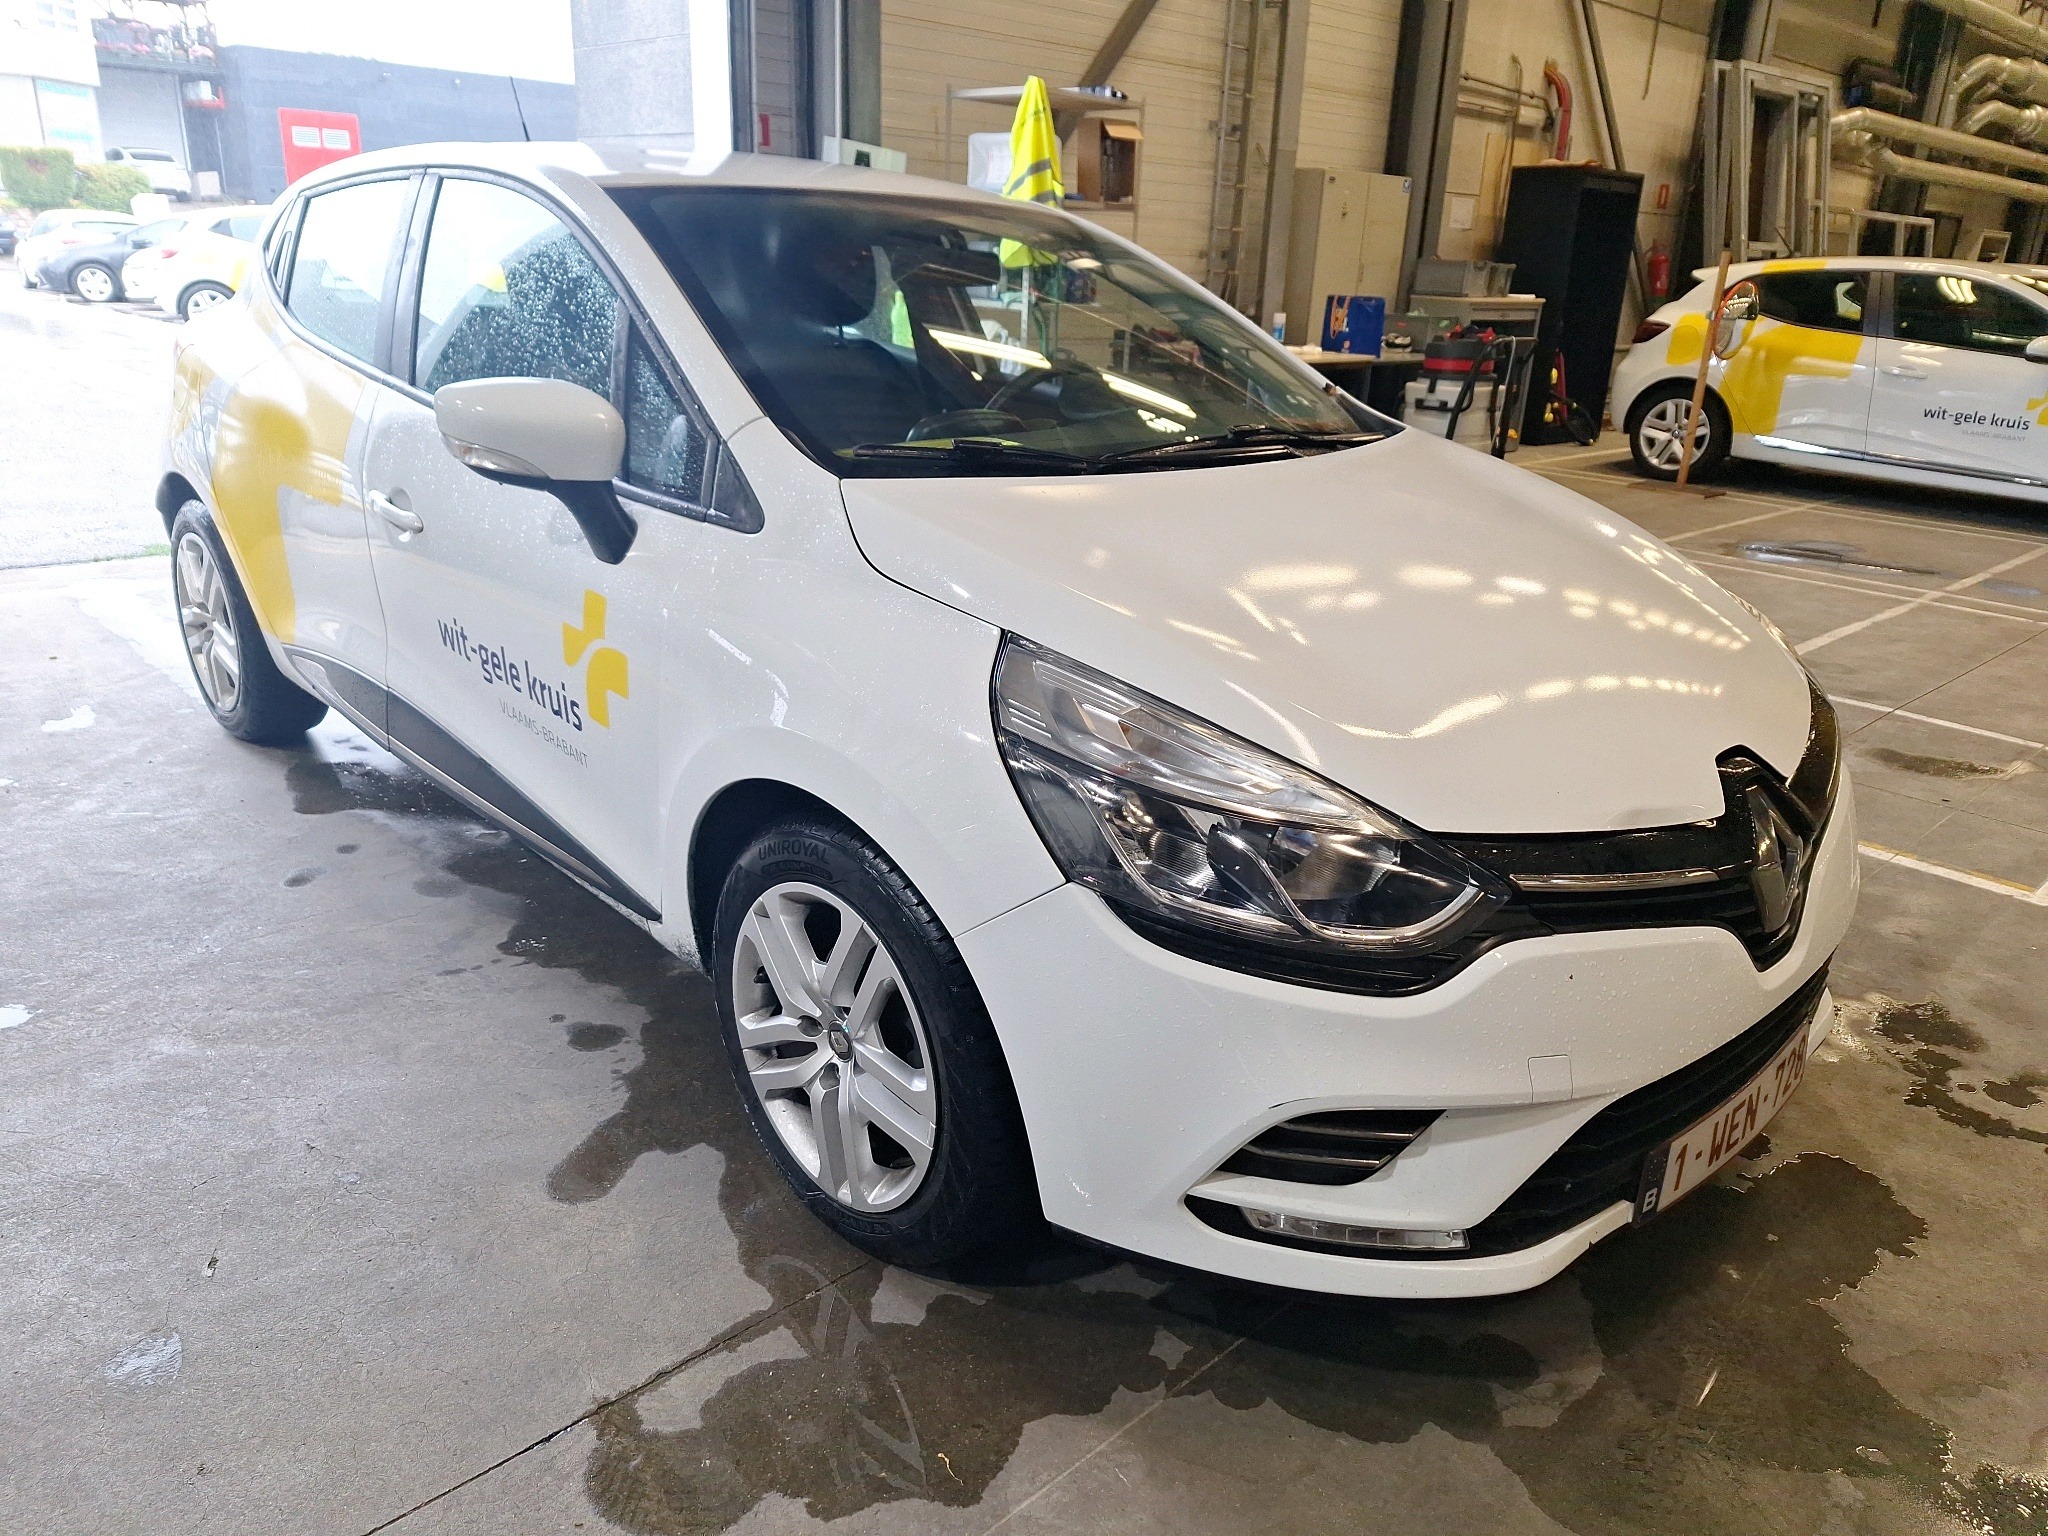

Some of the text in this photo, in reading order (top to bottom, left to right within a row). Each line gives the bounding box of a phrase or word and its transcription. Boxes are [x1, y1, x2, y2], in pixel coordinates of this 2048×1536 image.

[1923, 406, 2030, 430] wit-gele kruis
[437, 617, 583, 732] wit-gele kruis
[499, 699, 588, 768] VLAAMS-BRABANT
[758, 839, 829, 864] UNIROYAL
[1642, 1188, 1657, 1213] B
